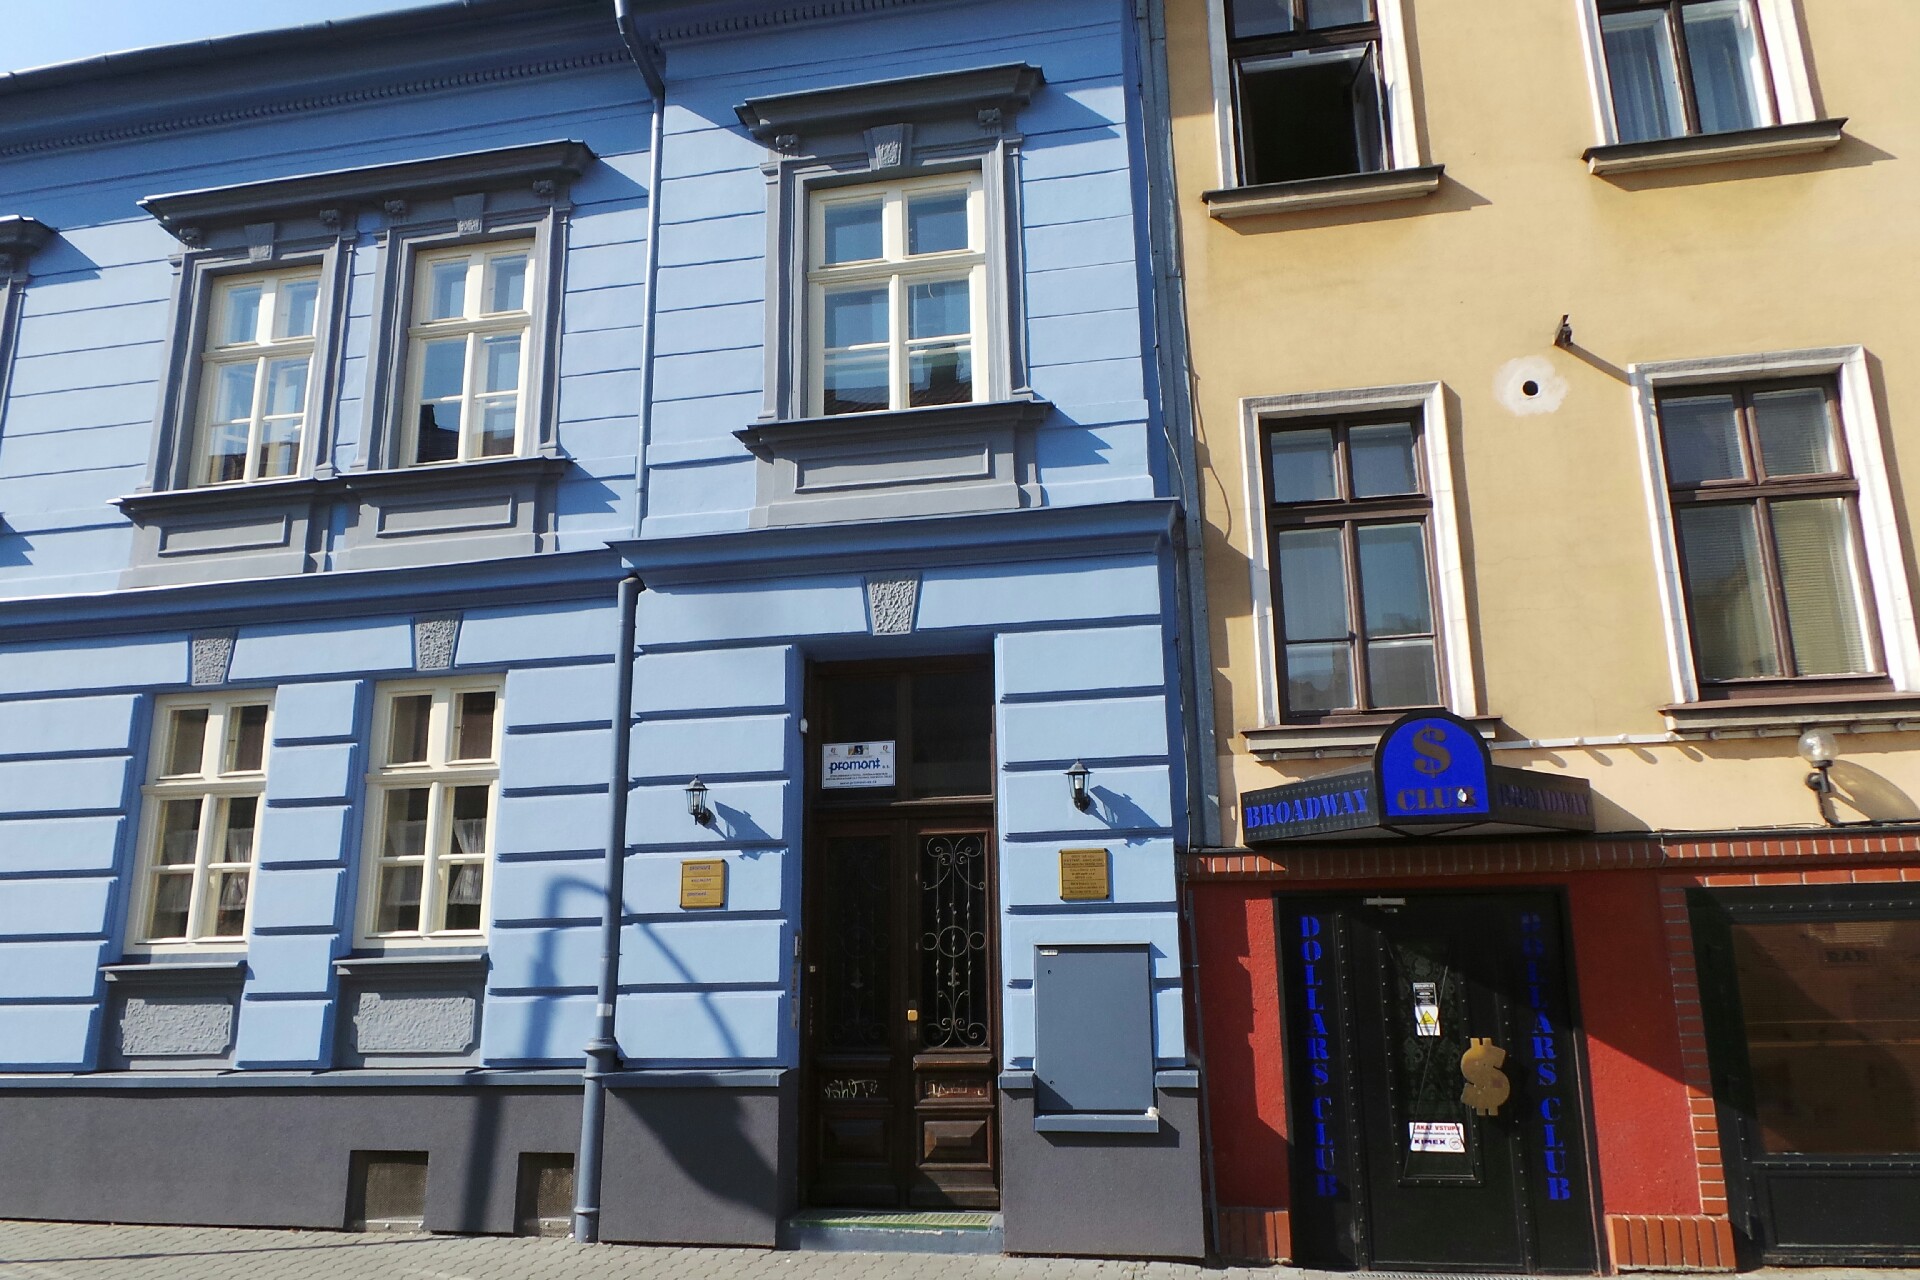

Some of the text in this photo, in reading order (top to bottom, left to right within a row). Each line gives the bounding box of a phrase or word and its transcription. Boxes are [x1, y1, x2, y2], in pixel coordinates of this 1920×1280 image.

[829, 757, 881, 774] promont
[1245, 789, 1369, 829] BROADWAY
[1499, 783, 1592, 816] BROADWAY
[1301, 916, 1338, 1196] DOLLARS CLUB
[1520, 912, 1571, 1200] DOLLARS CLUB
